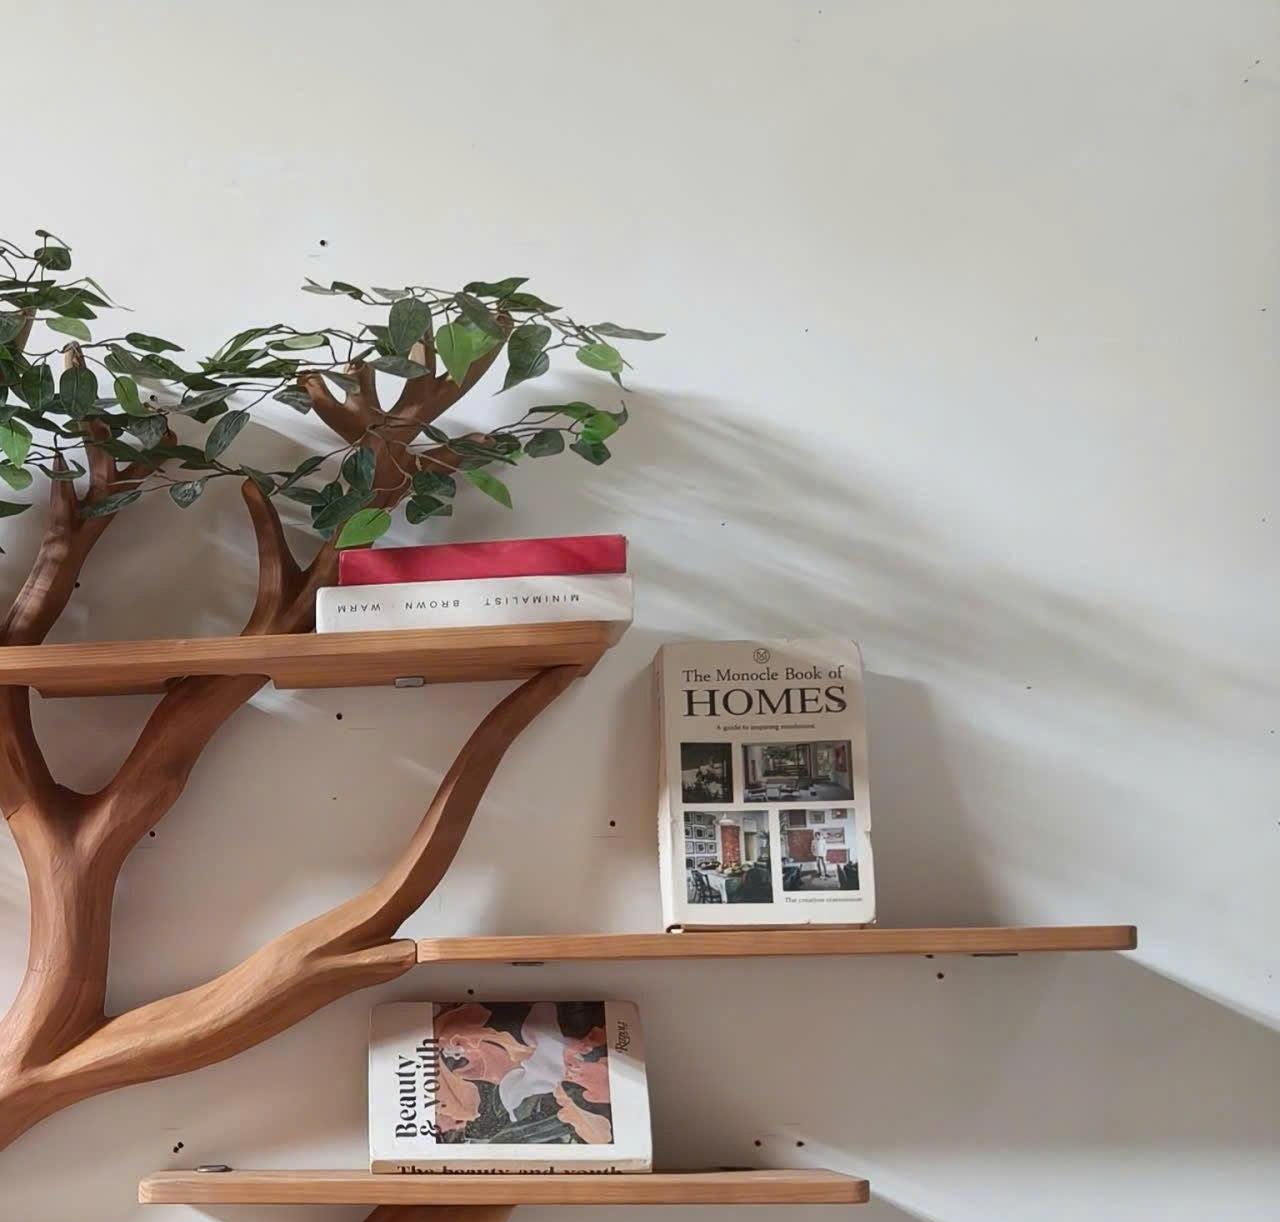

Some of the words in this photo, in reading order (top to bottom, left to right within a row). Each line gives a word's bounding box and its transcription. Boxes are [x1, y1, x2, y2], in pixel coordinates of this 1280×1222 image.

[337, 603, 381, 614] WARM
[404, 599, 460, 611] BROWN
[484, 593, 580, 607] MINIMALIST
[682, 669, 711, 683] The
[716, 668, 779, 682] Monocle
[785, 667, 823, 681] Book
[828, 665, 846, 679] of
[681, 685, 848, 717] HOMES
[417, 1037, 446, 1109] youth
[395, 1054, 421, 1139] Beauty
[419, 1120, 442, 1138] &
